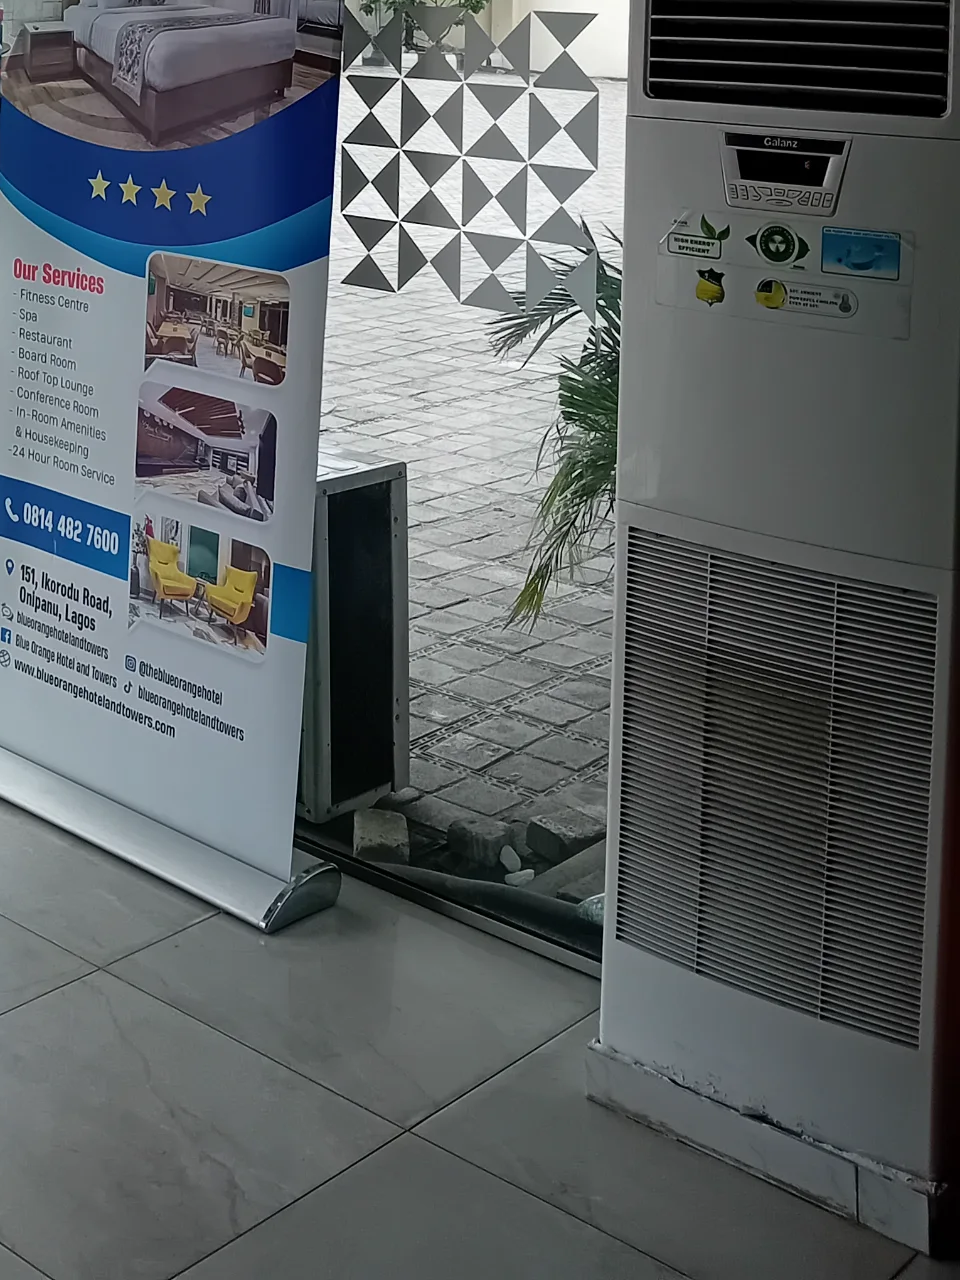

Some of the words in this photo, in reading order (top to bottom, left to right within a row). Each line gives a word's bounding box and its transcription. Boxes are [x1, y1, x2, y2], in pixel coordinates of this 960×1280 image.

[763, 136, 799, 149] Galanz
[673, 236, 689, 244] HIGH
[689, 238, 716, 248] ENERGY
[677, 245, 711, 255] EFFICIENT
[13, 258, 39, 281] Our
[42, 263, 105, 296] Services
[18, 307, 38, 324] Spa
[19, 288, 57, 308] Fitness
[57, 296, 90, 314] Centre
[18, 326, 73, 351] Restaurant
[17, 347, 48, 365] Board
[49, 353, 77, 372] Room
[16, 366, 41, 384] Roof
[42, 372, 59, 388] Top
[60, 376, 94, 397] Lounge
[16, 385, 72, 412] Conference
[72, 400, 100, 419] Room
[15, 405, 59, 429] In-Room
[60, 417, 107, 442] Amenities
[14, 425, 23, 439] &
[24, 426, 90, 460] Housekeeping
[27, 448, 51, 465] Hour
[52, 455, 80, 475] Room
[80, 463, 116, 487] Service
[23, 501, 54, 534] 0814
[57, 513, 83, 544] 482
[86, 523, 120, 556] 7600
[19, 585, 62, 623] Onipanu,
[64, 602, 97, 633] Lagos
[20, 563, 39, 590] 151,
[40, 569, 81, 602] Ikorodu
[81, 580, 114, 619] Road,
[16, 609, 110, 661] blueorangehotelandtowers
[15, 633, 30, 651] Blue
[30, 638, 56, 664] Orange
[56, 649, 76, 669] Hotel
[75, 657, 90, 677] and
[90, 664, 118, 689] Towers
[14, 659, 176, 739] www.blueorangehotelandtowers.com
[138, 659, 224, 707] @theblueorangehotel
[137, 685, 245, 742] blueorangehotelandtowers
